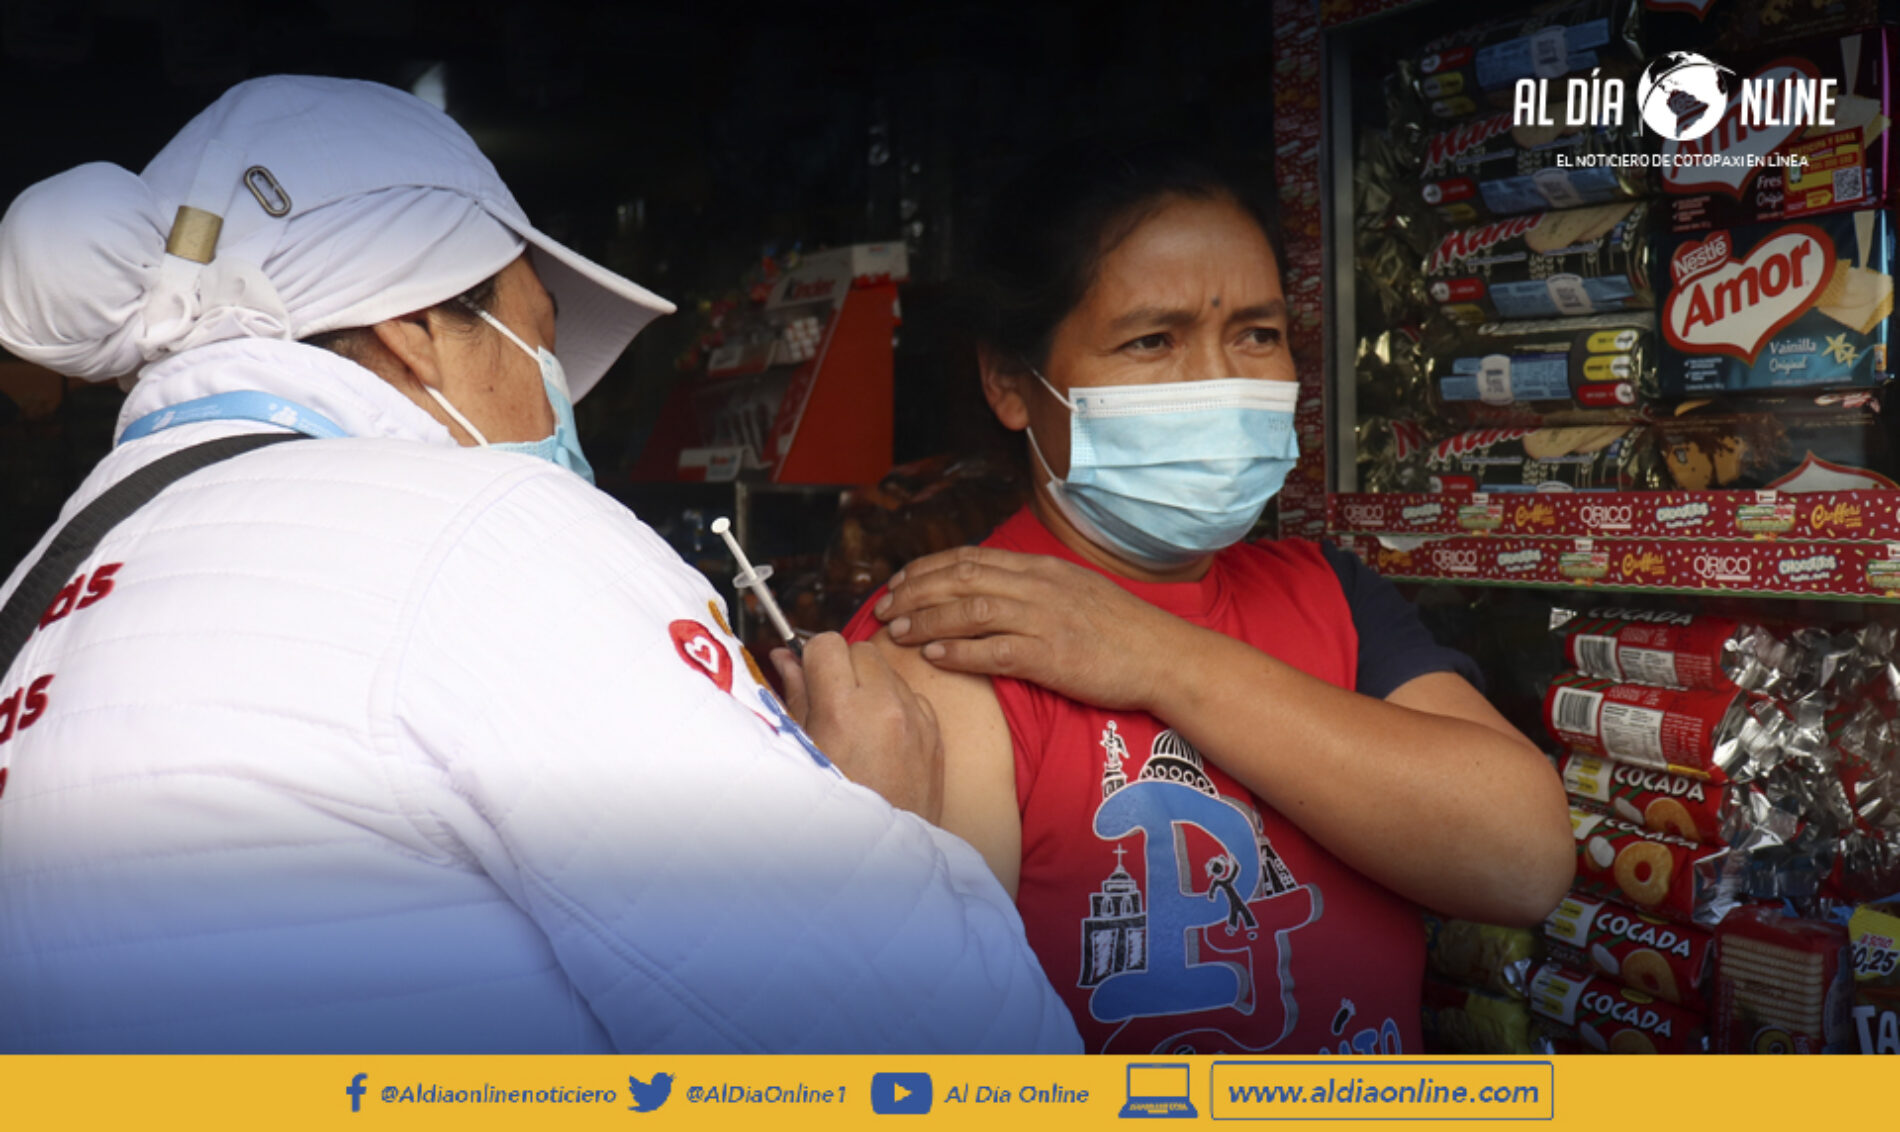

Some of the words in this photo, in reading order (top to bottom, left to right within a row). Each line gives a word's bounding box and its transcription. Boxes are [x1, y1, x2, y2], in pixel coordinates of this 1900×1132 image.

[1682, 238, 1812, 338] Amor
[1769, 339, 1817, 356] Vainilla
[1614, 766, 1705, 802] COCADA
[1595, 912, 1691, 958] COCADA
[1581, 990, 1673, 1039] COCADA
